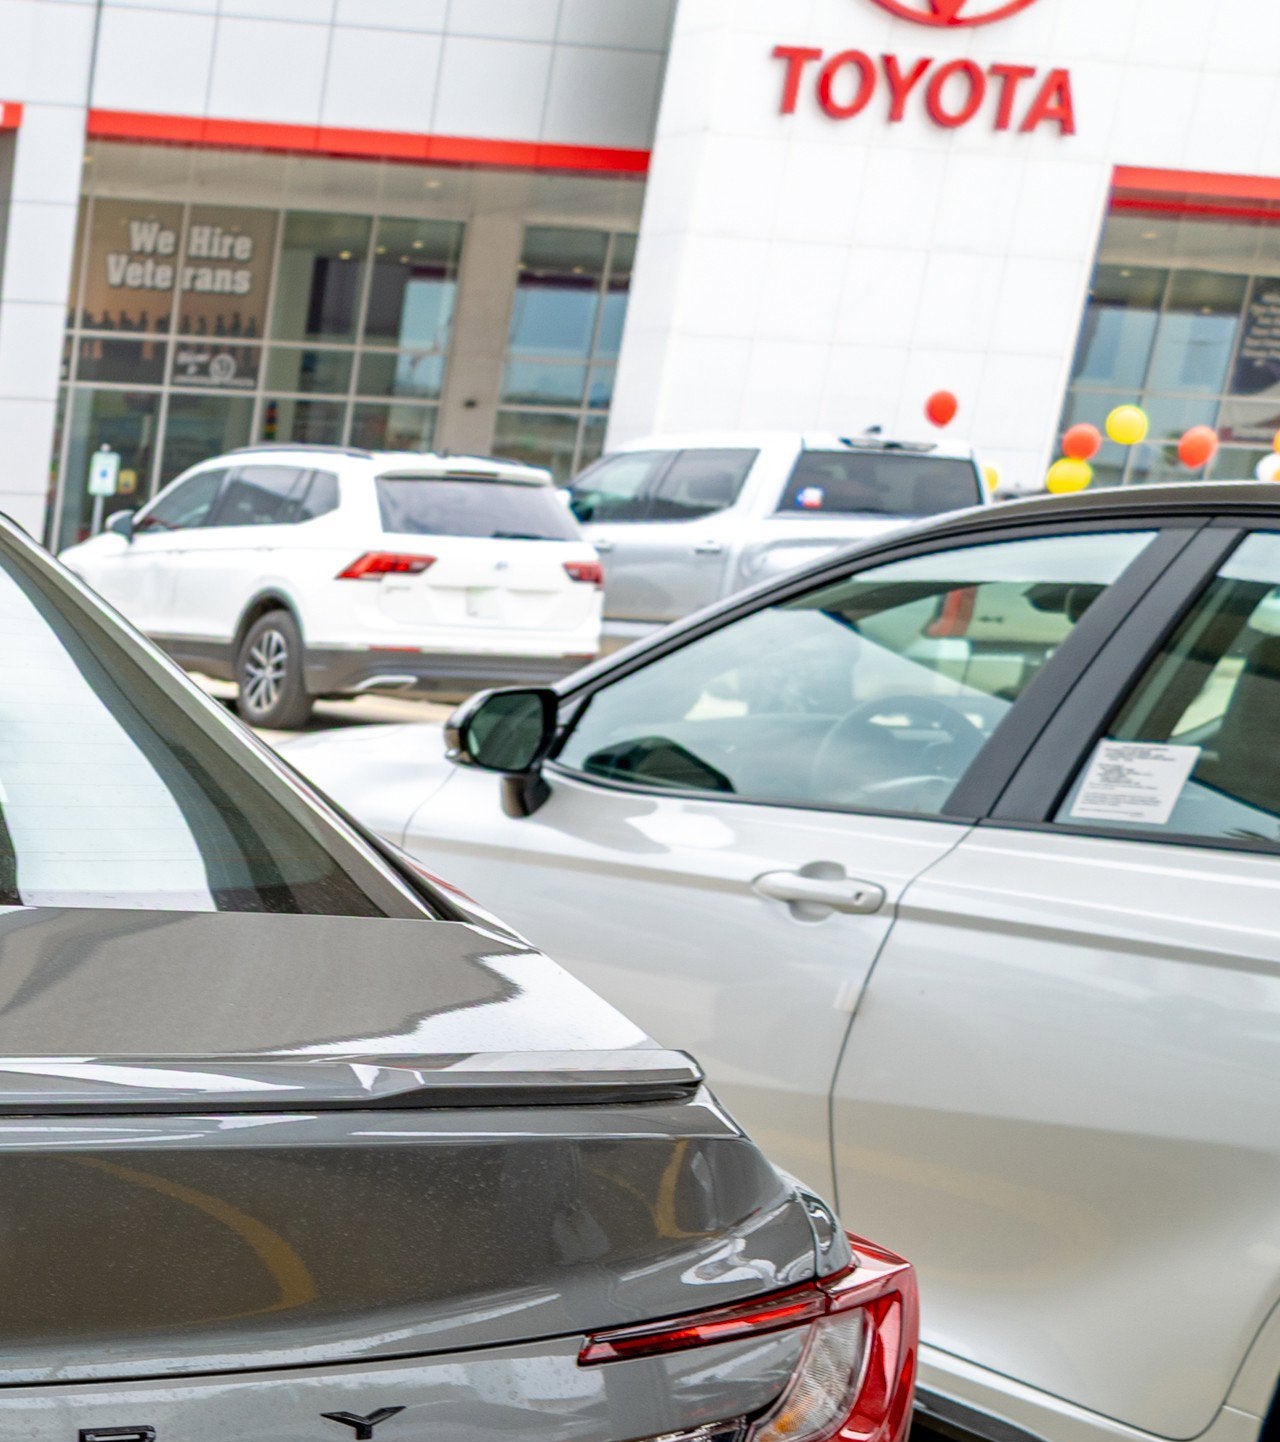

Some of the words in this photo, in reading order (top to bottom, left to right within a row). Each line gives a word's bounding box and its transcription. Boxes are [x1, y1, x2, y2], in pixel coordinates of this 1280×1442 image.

[771, 45, 1076, 136] TOYOTA
[130, 220, 176, 255] We
[189, 225, 253, 260] Hire
[107, 253, 251, 295] Veterans
